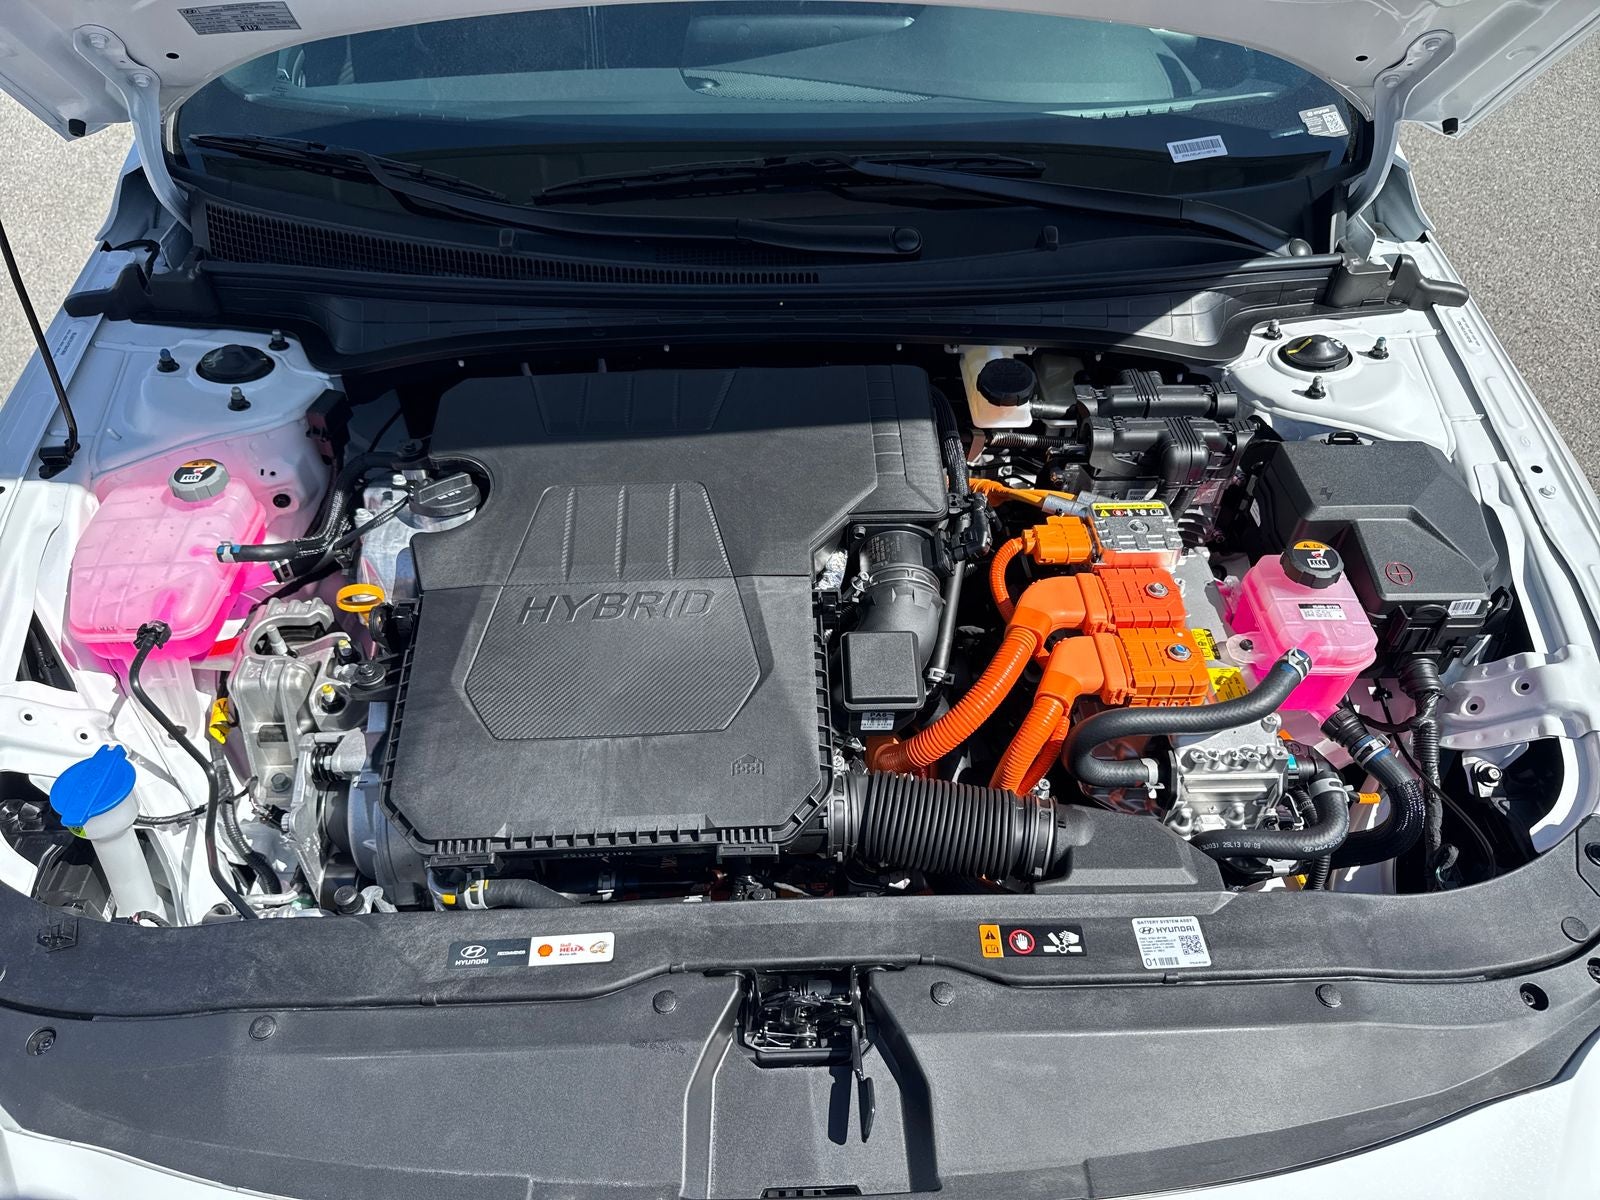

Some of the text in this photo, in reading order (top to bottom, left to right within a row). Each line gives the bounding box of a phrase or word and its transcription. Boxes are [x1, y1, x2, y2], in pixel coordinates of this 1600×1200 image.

[517, 589, 715, 625] HYBRID
[1156, 925, 1196, 934] HYUNDAI
[560, 944, 585, 953] HELIX
[455, 958, 489, 966] HYUNDAI
[1145, 957, 1158, 967] 01
